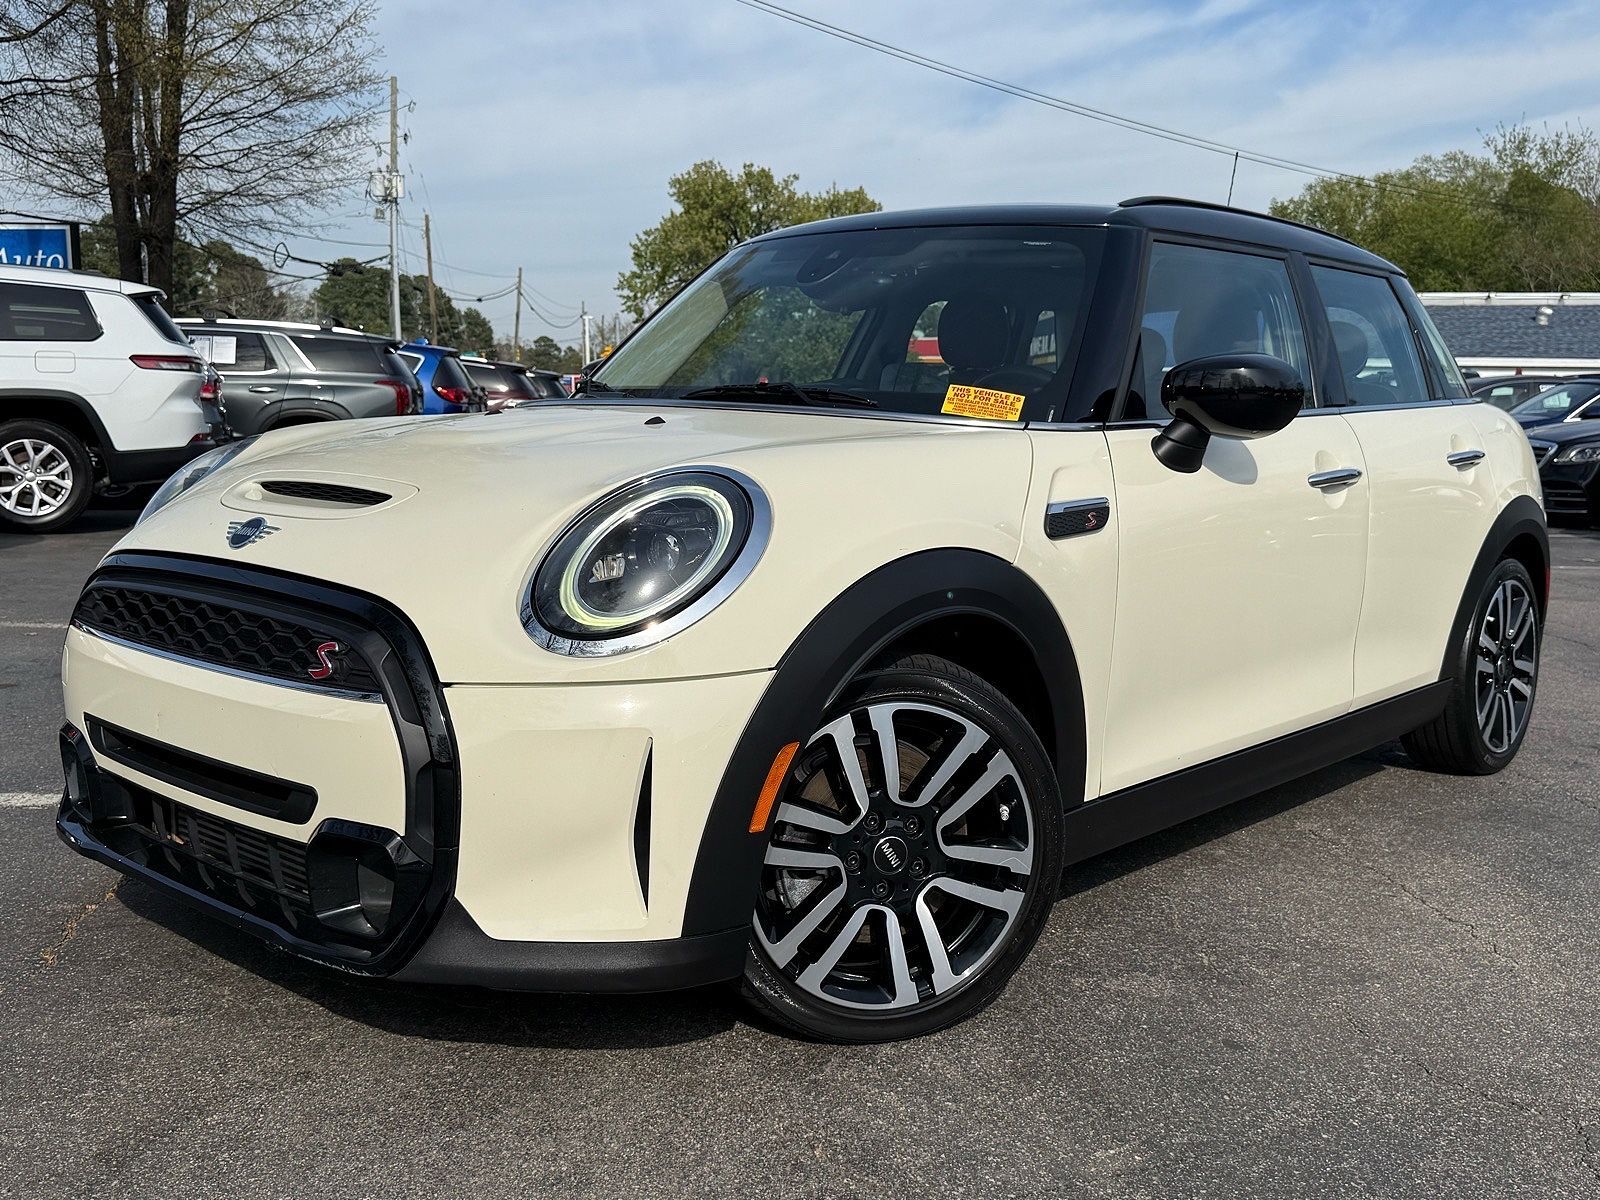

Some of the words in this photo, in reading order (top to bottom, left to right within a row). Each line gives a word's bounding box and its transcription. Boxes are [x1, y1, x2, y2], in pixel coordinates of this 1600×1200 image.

[973, 389, 1010, 400] VEHICLE
[993, 398, 1016, 407] SALE
[308, 641, 339, 680] S
[881, 842, 901, 868] MINI
